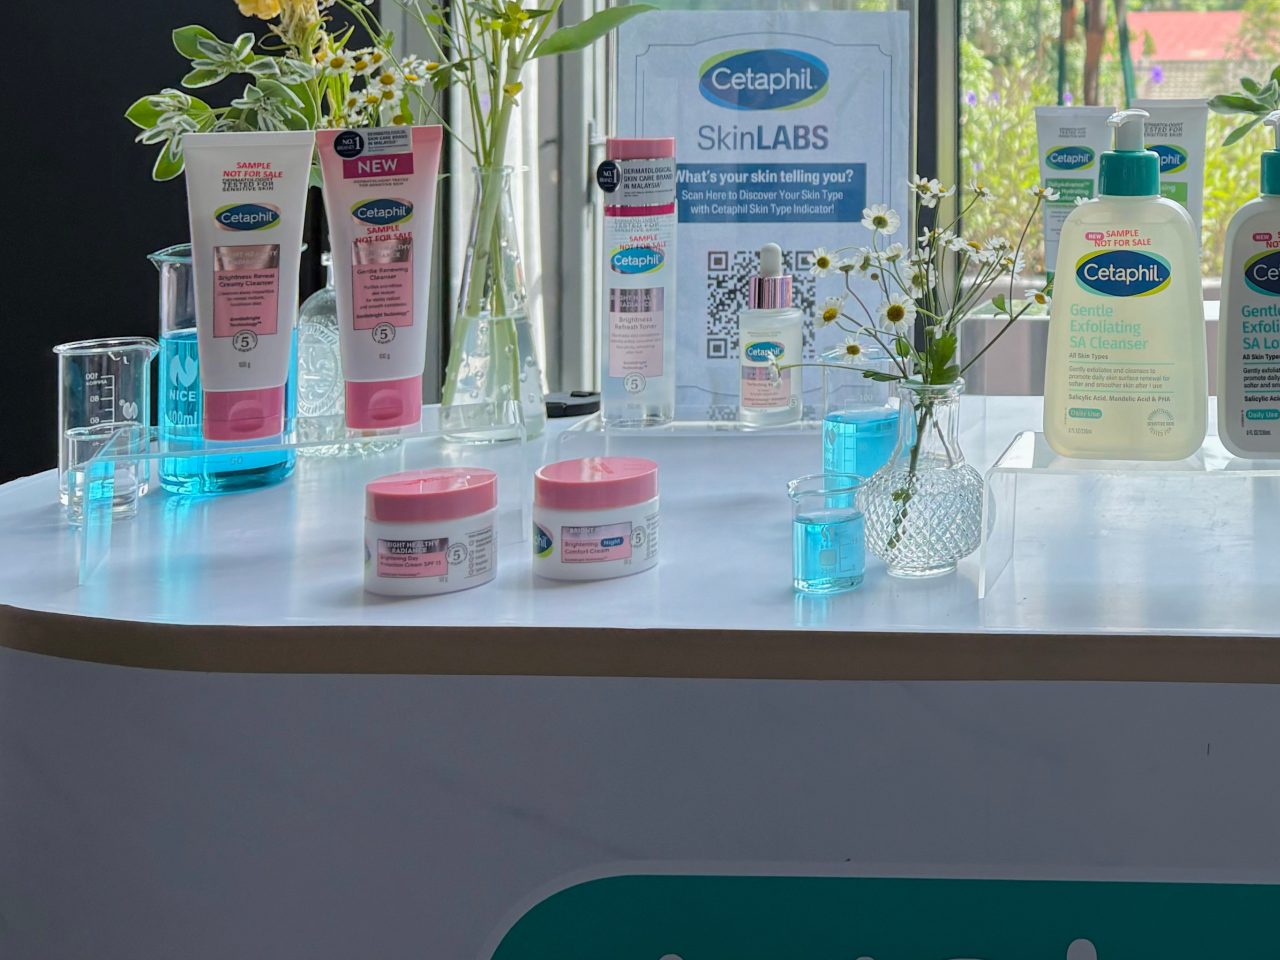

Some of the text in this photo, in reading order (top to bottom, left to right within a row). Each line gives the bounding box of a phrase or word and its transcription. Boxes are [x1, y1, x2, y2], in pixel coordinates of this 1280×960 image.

[711, 66, 813, 95] Cetaphil
[697, 124, 829, 151] SkinLABS
[1049, 153, 1090, 165] Cetaphil
[236, 161, 271, 170] SAMPLE
[357, 158, 398, 174] NEW
[623, 167, 672, 175] DERMATOLOGICAL
[223, 170, 283, 179] NOT FOR SALE
[675, 168, 854, 185] What's your skin telling you?
[681, 190, 844, 202] Scan Here to Discover Your Skin Type
[357, 206, 407, 219] Cetaphil
[690, 204, 835, 216] with Cetaphil Skin Type Indicator!
[221, 211, 273, 224] Cetaphil
[366, 224, 400, 234] SAMPLE
[1105, 229, 1139, 238] SAMPLE
[355, 236, 372, 244] NOT
[393, 232, 413, 241] SALE
[629, 234, 658, 242] SAMPLE
[1094, 238, 1152, 248] NOT FOR SALE
[613, 255, 660, 268] Cetaphil
[1083, 263, 1160, 285] Cetaphil
[1070, 303, 1113, 317] Gentle
[380, 329, 388, 339] 5
[1069, 319, 1142, 337] Exfoliating
[240, 336, 250, 348] 5
[1069, 335, 1149, 350] SA Cleanser
[1242, 336, 1260, 350] SA
[630, 379, 639, 390] 5
[169, 390, 197, 402] NICE
[1068, 393, 1092, 401] Salicylic
[1244, 395, 1269, 403] Salicylic
[453, 549, 461, 560] 5
